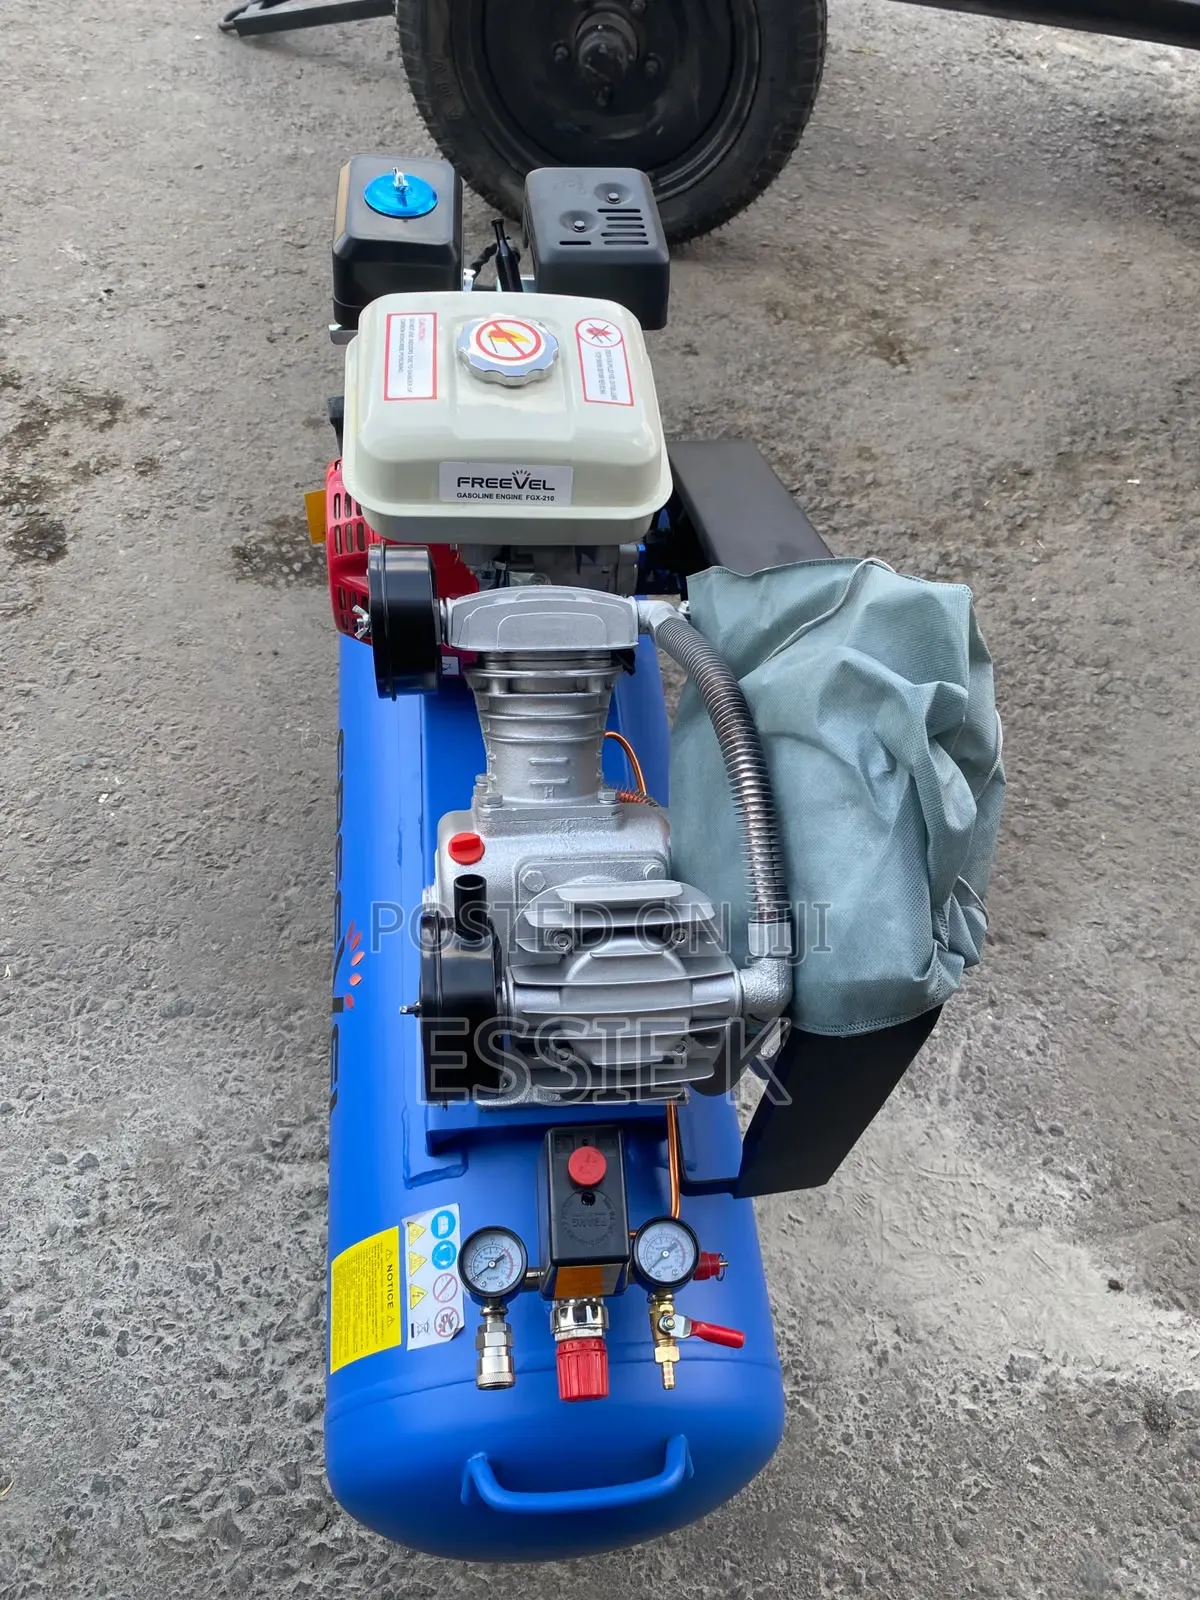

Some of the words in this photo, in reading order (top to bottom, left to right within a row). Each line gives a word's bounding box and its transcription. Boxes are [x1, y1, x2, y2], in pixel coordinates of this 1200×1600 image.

[457, 475, 556, 491] FREEVEL
[456, 492, 494, 500] GASOLINE
[495, 493, 523, 501] ENGINE
[386, 1264, 395, 1309] NOTICE
